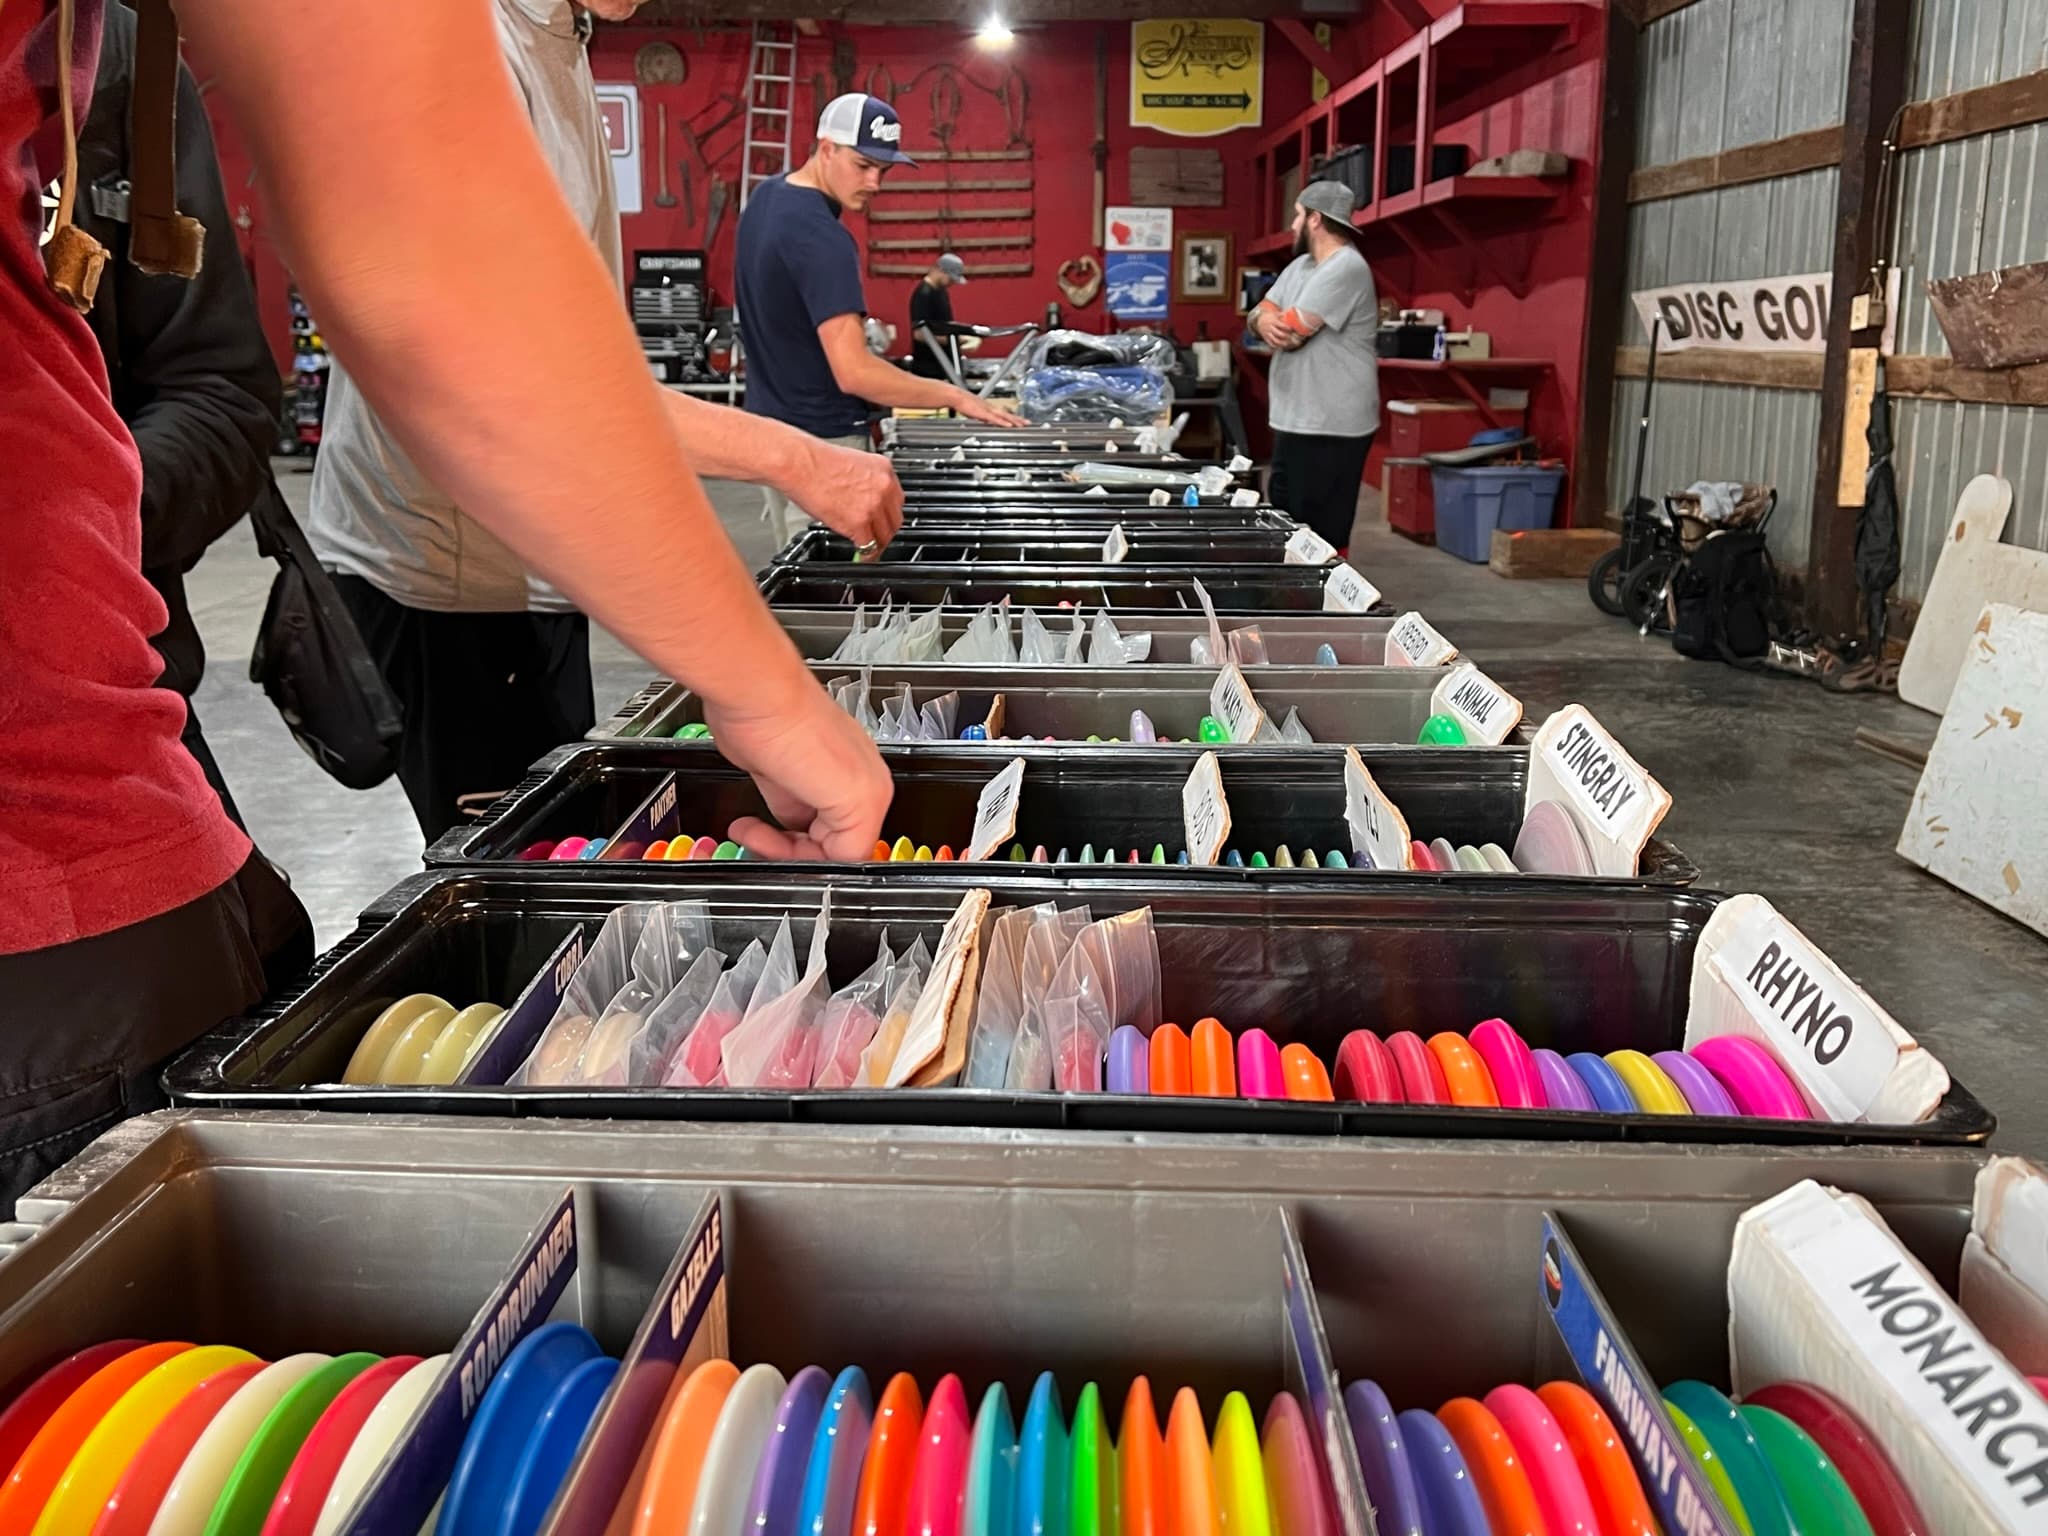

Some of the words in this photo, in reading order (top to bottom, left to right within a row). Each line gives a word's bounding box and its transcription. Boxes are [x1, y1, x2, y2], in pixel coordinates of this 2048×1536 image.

[1658, 290, 1744, 341] DISC
[1450, 678, 1500, 725] ANIMAL
[1556, 722, 1636, 820] STINGRAY
[555, 934, 584, 997] COBRA
[1746, 940, 1853, 1066] RHYNO
[460, 1207, 574, 1420] ROADRUNNER
[671, 1209, 721, 1341] GAZELLE
[1594, 1327, 1678, 1495] FAIRWAY
